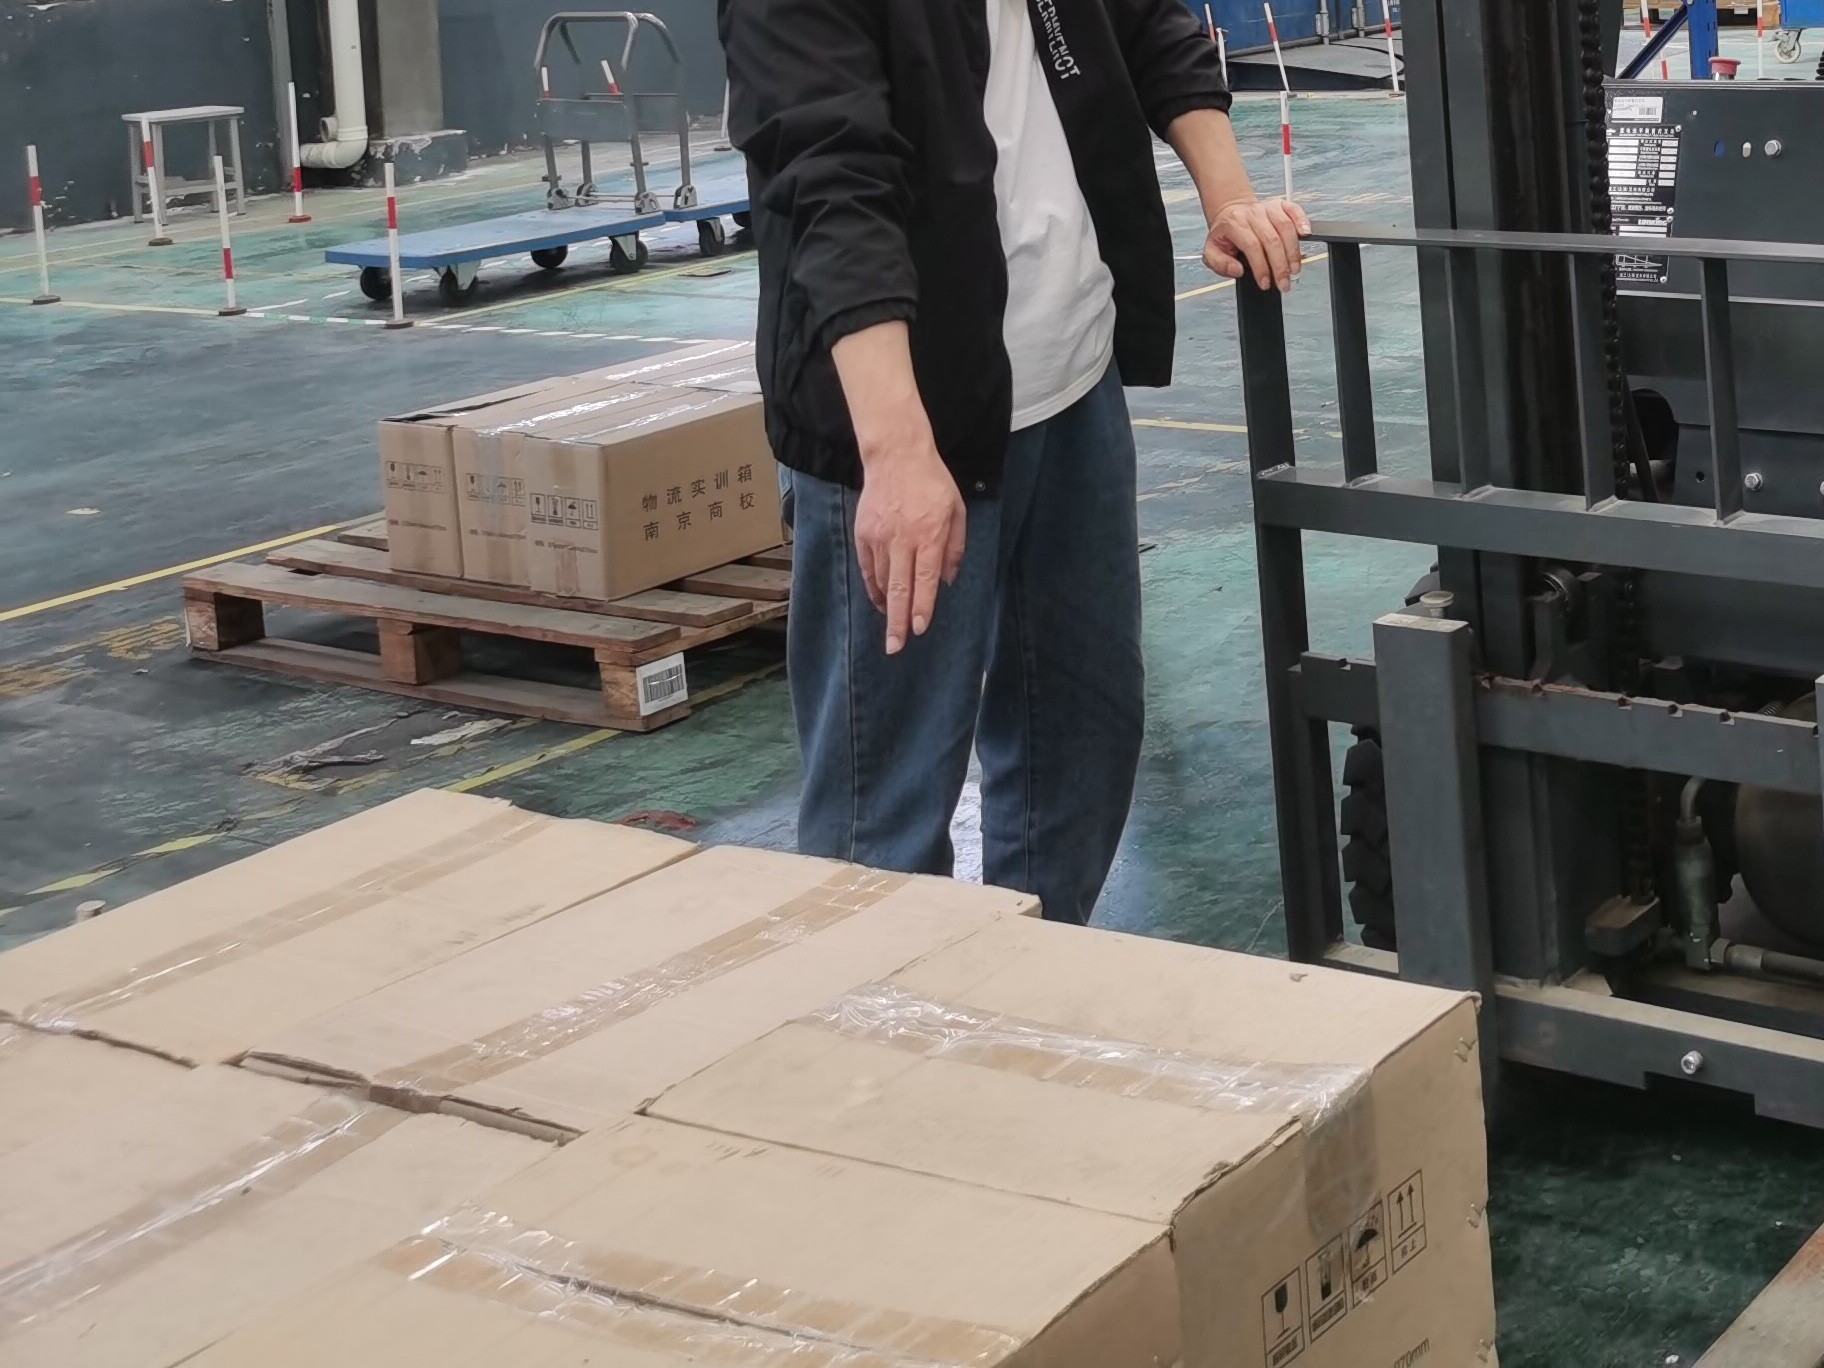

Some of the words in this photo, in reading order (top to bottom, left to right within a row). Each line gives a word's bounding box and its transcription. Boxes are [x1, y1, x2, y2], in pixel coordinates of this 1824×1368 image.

[641, 463, 753, 512] 物流实训箱
[643, 492, 755, 541] 南京商校
